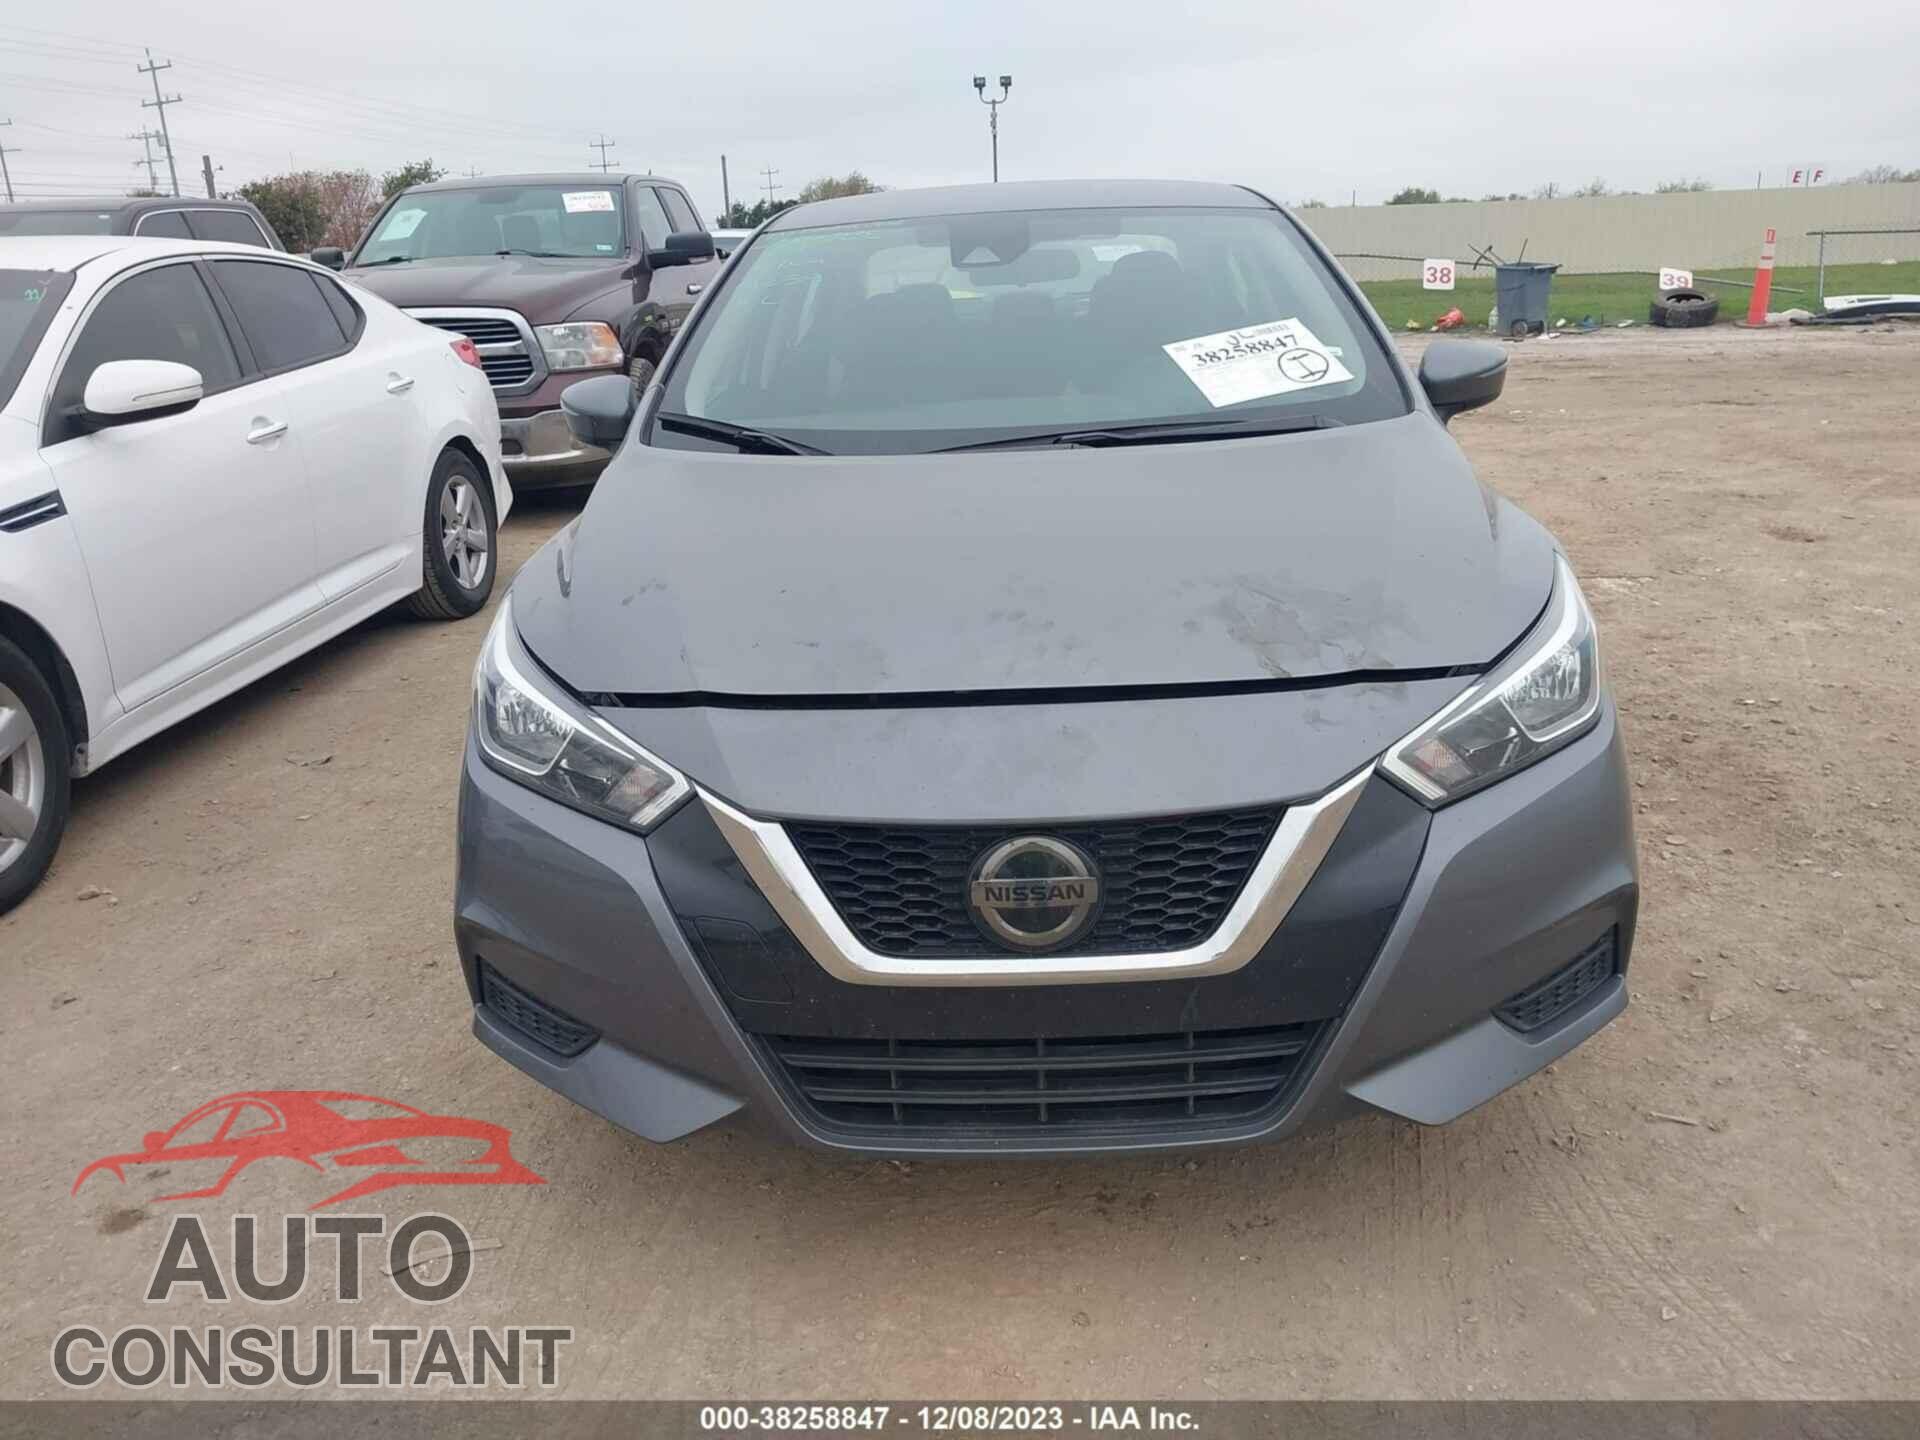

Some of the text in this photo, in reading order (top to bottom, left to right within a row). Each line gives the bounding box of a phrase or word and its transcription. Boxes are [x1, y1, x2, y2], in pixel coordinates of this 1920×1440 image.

[1792, 170, 1803, 183] E
[1813, 170, 1824, 183] F
[1426, 266, 1452, 284] 38
[1663, 273, 1689, 288] 39
[1192, 334, 1298, 367] 38258847
[984, 884, 1085, 902] NISSAN
